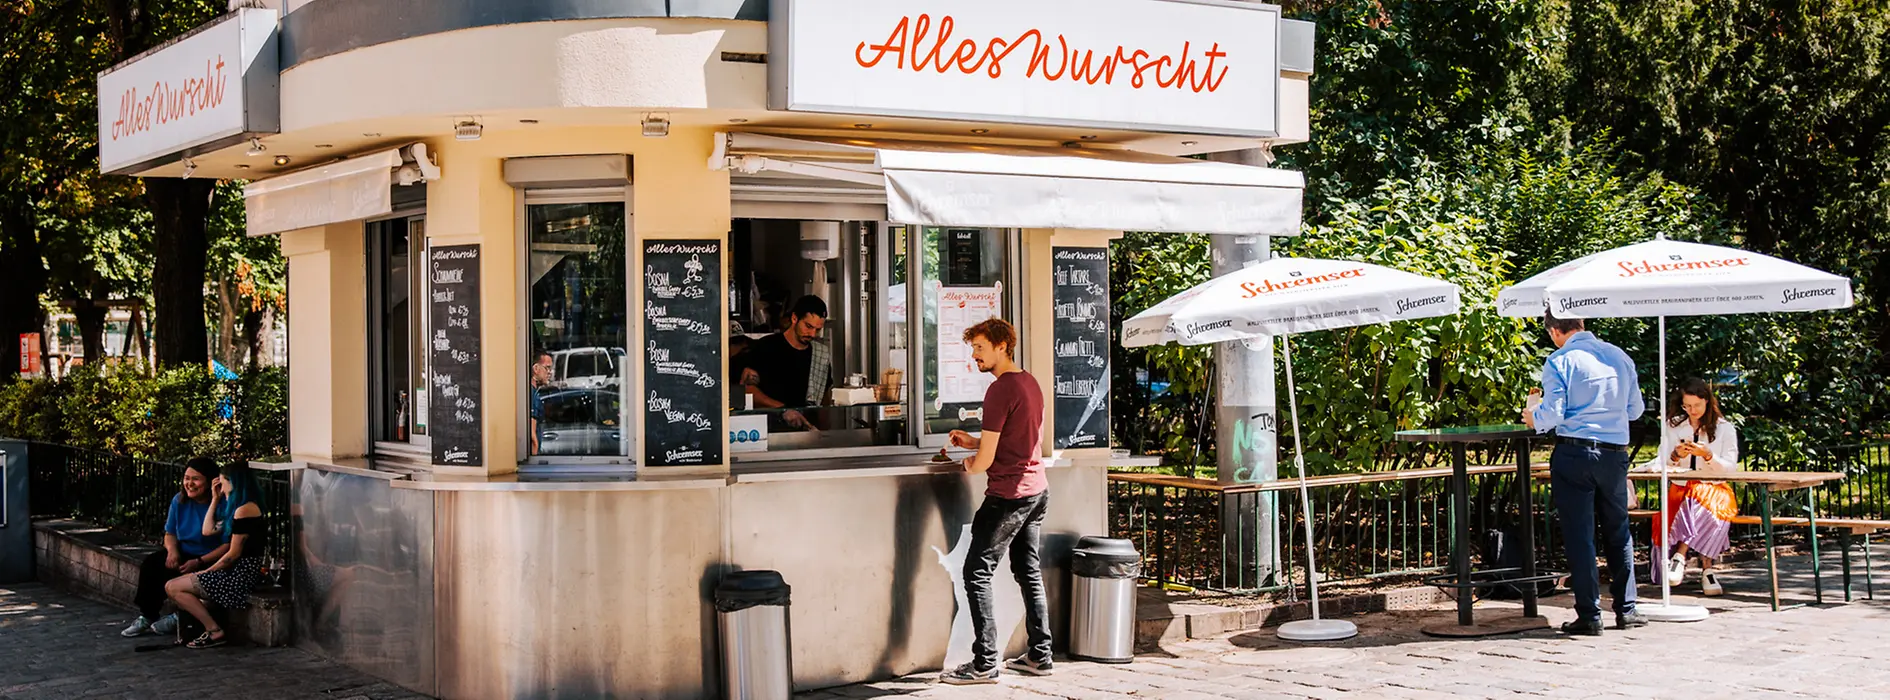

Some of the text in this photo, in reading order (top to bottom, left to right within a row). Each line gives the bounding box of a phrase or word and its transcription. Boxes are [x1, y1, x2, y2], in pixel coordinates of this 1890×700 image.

[1616, 256, 1751, 278] Schremser
[1239, 267, 1367, 299] Schremser
[1395, 294, 1448, 316] Schremser
[1558, 296, 1609, 313] Schremser
[1780, 286, 1837, 305] Schremser
[1186, 318, 1233, 340] Schremser
[664, 409, 686, 423] VEGAN
[664, 449, 704, 463] Schremser
